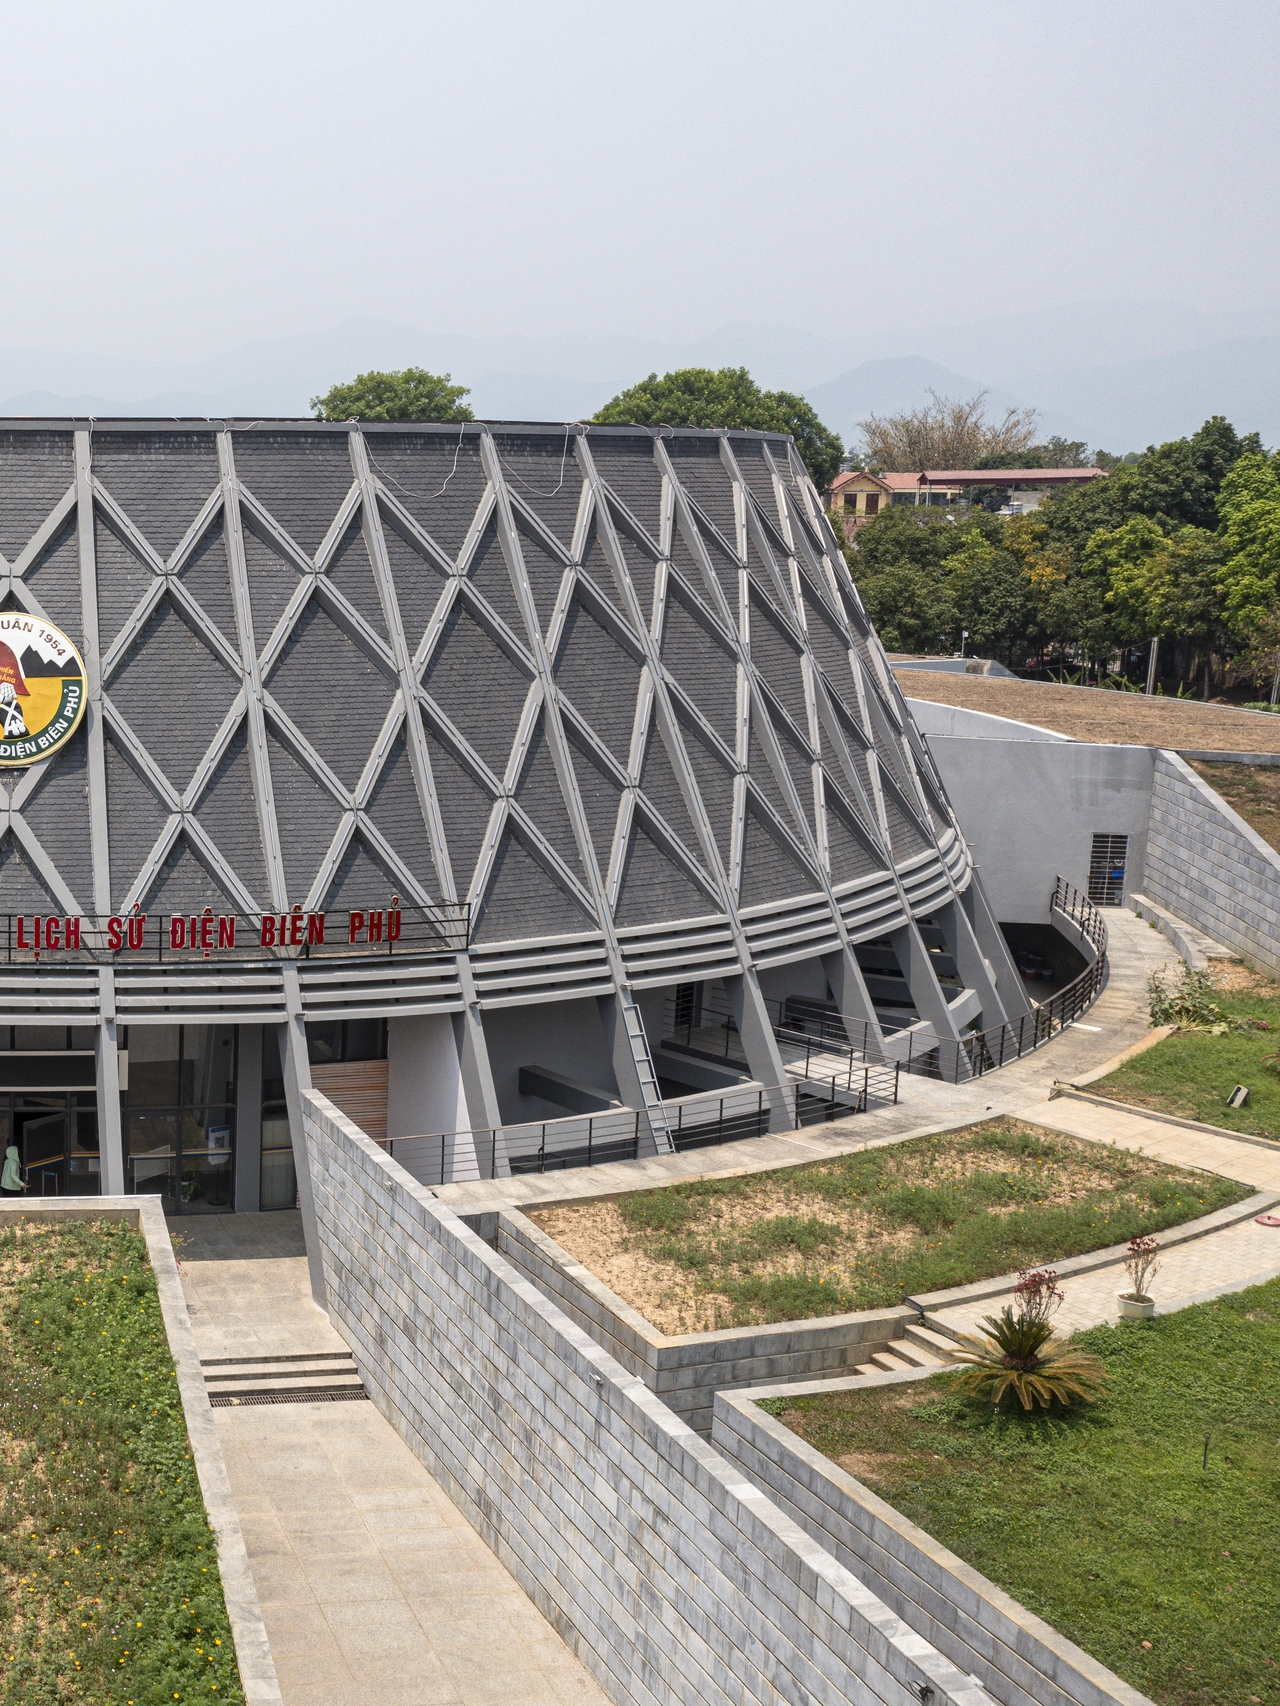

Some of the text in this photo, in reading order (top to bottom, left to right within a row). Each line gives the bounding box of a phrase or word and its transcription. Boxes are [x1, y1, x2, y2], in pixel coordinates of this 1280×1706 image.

[39, 628, 67, 656] 1954
[0, 742, 38, 758] ĐIỆN
[38, 719, 69, 748] BIÊN
[64, 686, 80, 718] PHỦ
[16, 914, 81, 958] LỊCH
[107, 902, 148, 950] SỬ
[170, 906, 236, 958] ĐIỆN
[260, 904, 326, 948] BIÊN
[349, 895, 402, 944] PHỦ
